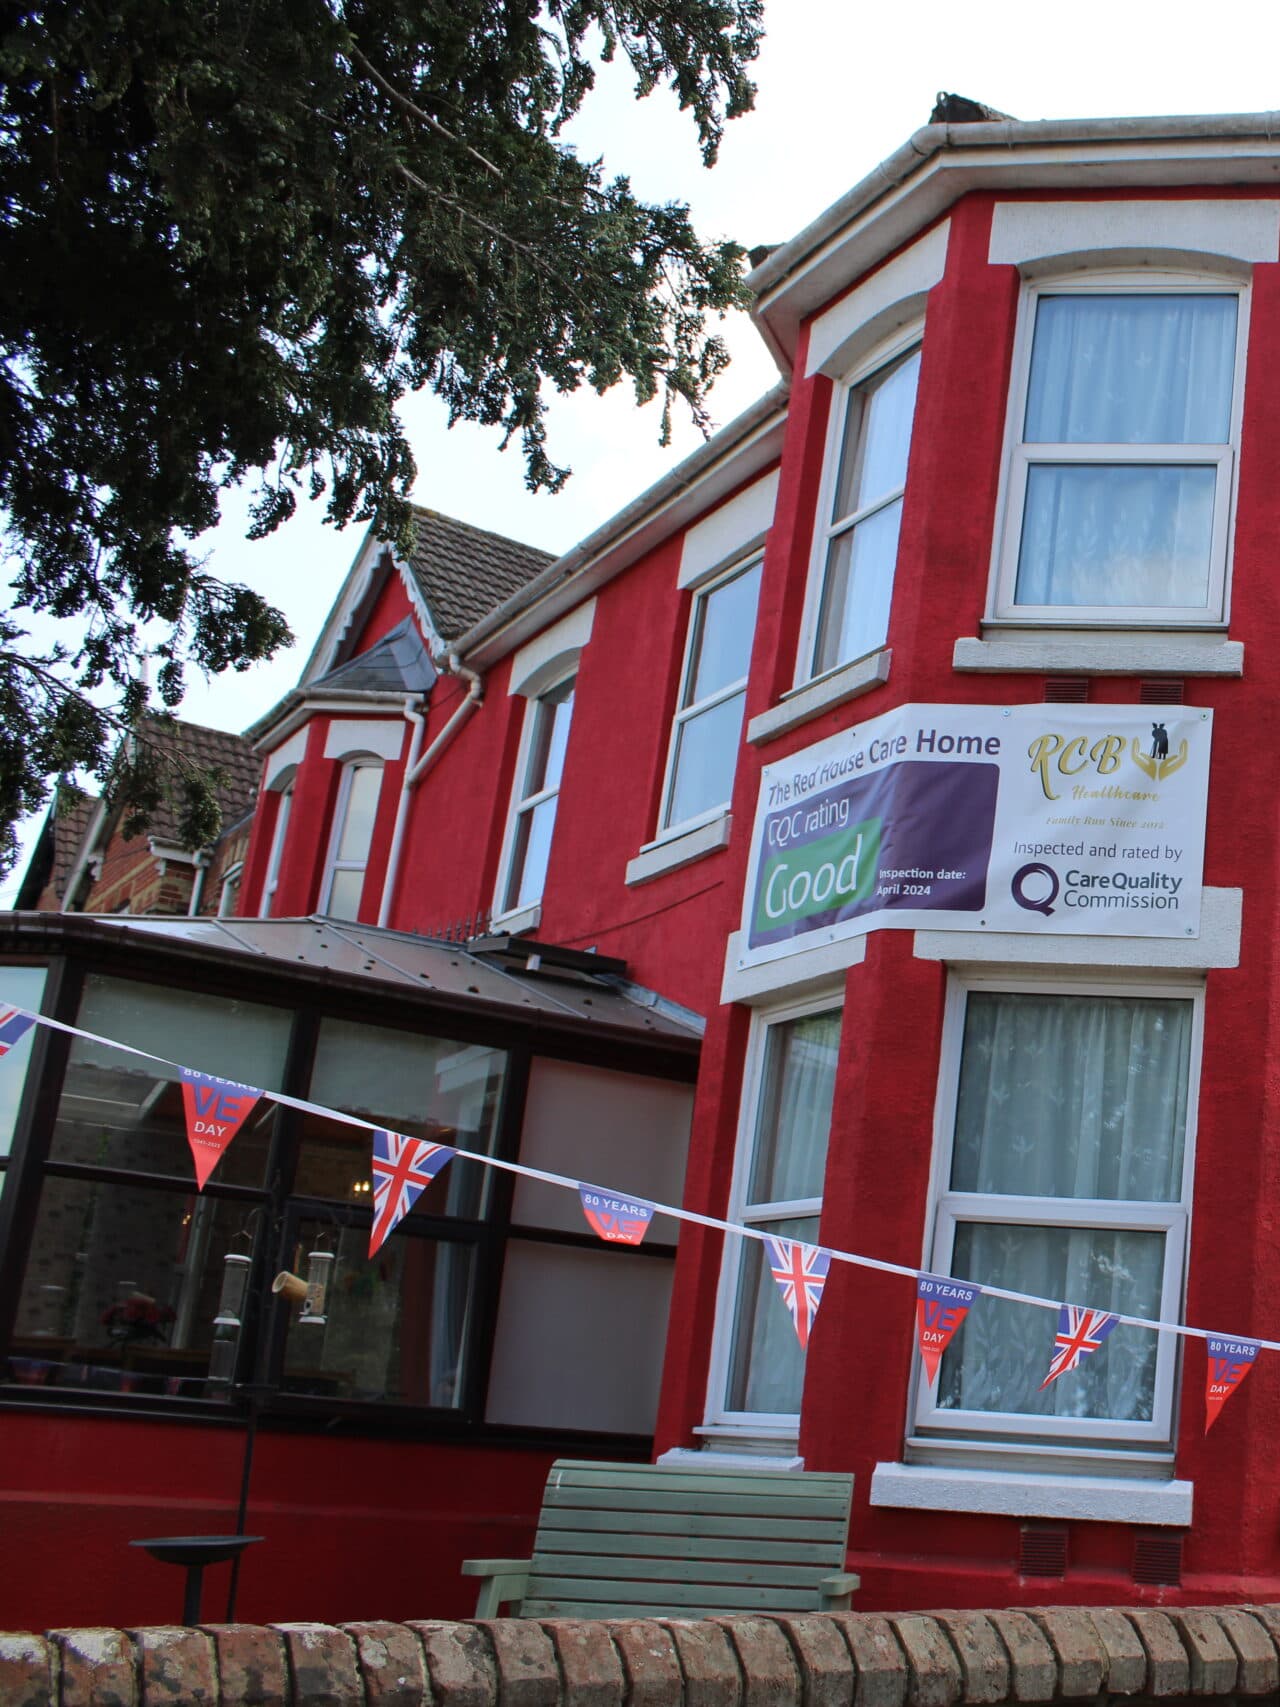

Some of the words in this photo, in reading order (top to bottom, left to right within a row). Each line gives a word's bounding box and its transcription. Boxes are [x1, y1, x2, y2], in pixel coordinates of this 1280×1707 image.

[768, 781, 791, 807] The
[793, 766, 820, 797] Red
[820, 751, 864, 785] House
[869, 735, 907, 764] Care
[916, 729, 1001, 755] Home
[1028, 733, 1128, 801] RCB
[1071, 784, 1161, 802] Healthcare
[767, 811, 803, 847] CQC
[804, 798, 850, 833] rating
[1045, 816, 1082, 827] Family
[1109, 817, 1138, 829] Since
[1014, 841, 1085, 858] Inspected
[1089, 843, 1117, 859] and
[1121, 845, 1160, 859] rated
[1164, 845, 1184, 863] by
[765, 833, 863, 919] Good
[879, 868, 934, 882] Inspection
[936, 868, 967, 881] date:
[1065, 869, 1110, 889] Care
[1112, 872, 1184, 895] Quality
[876, 885, 900, 898] April
[902, 885, 932, 896] 2024
[1063, 889, 1180, 910] Commission
[183, 1068, 201, 1078] 80
[194, 1083, 240, 1124] VE
[194, 1121, 227, 1137] DAY
[584, 1193, 600, 1206] 80
[602, 1198, 648, 1217] YEARS
[595, 1210, 641, 1235] VE
[606, 1231, 633, 1241] DAY
[920, 1281, 933, 1293] 80
[935, 1284, 973, 1301] YEARS
[924, 1299, 956, 1332] VE
[922, 1331, 945, 1343] DAY
[1210, 1341, 1222, 1352] 80
[1223, 1343, 1256, 1356] YEARS
[1214, 1357, 1242, 1384] VE
[1210, 1384, 1230, 1394] DAY
